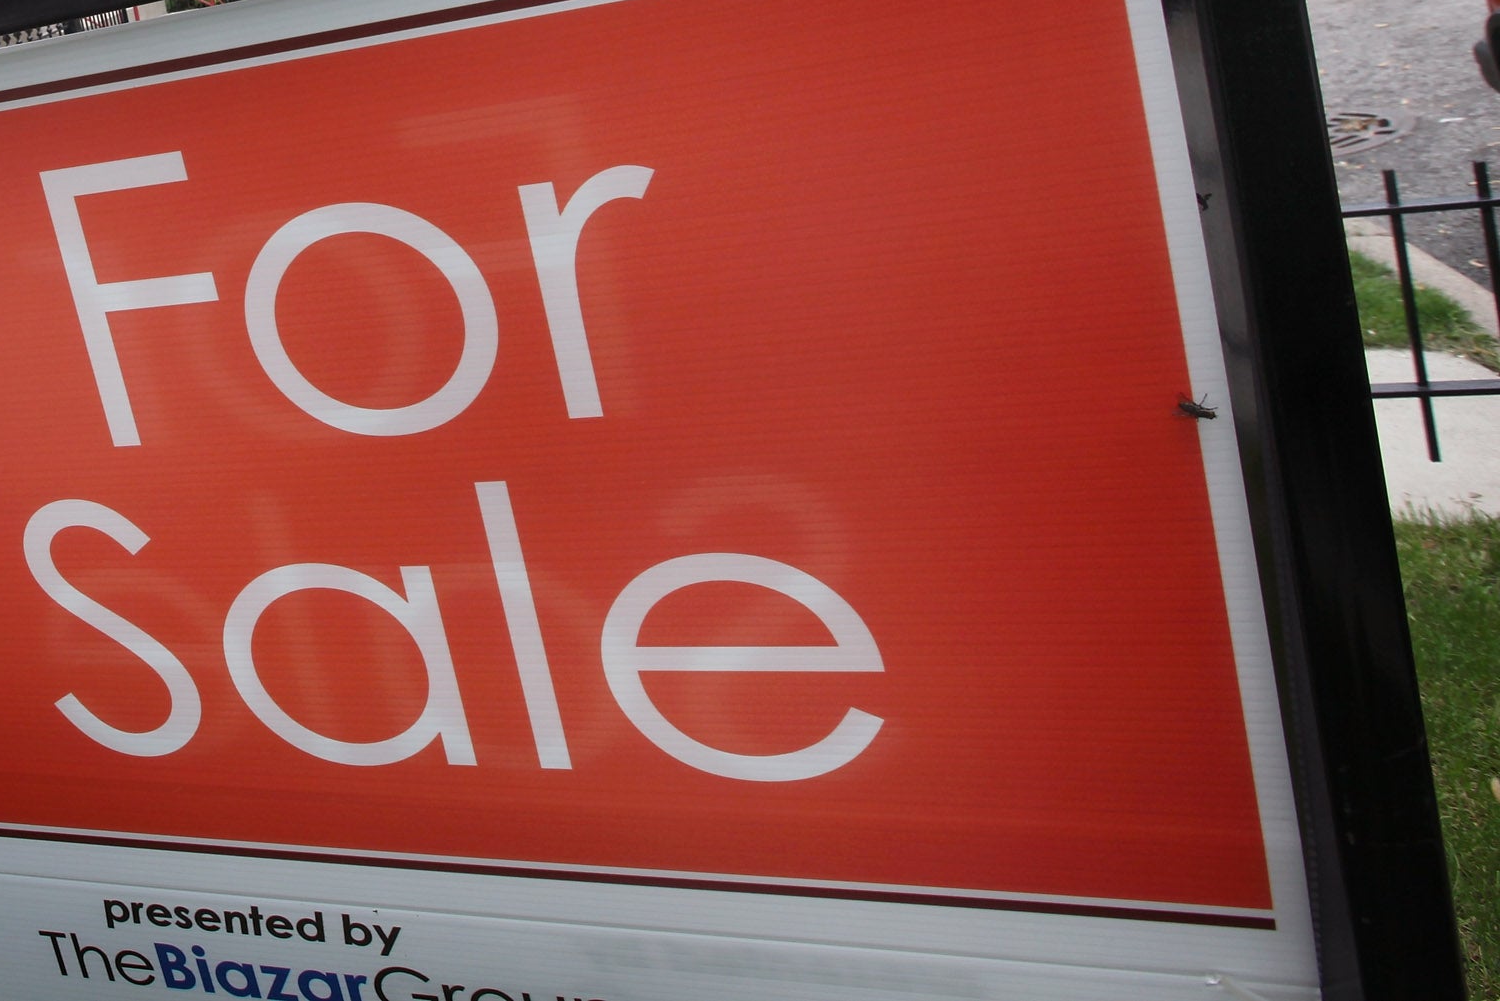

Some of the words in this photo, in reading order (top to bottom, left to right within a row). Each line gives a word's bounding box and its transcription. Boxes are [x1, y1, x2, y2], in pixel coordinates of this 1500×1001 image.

[39, 151, 655, 447] For
[23, 481, 885, 782] Sale
[103, 899, 326, 942] presented
[341, 914, 402, 957] by
